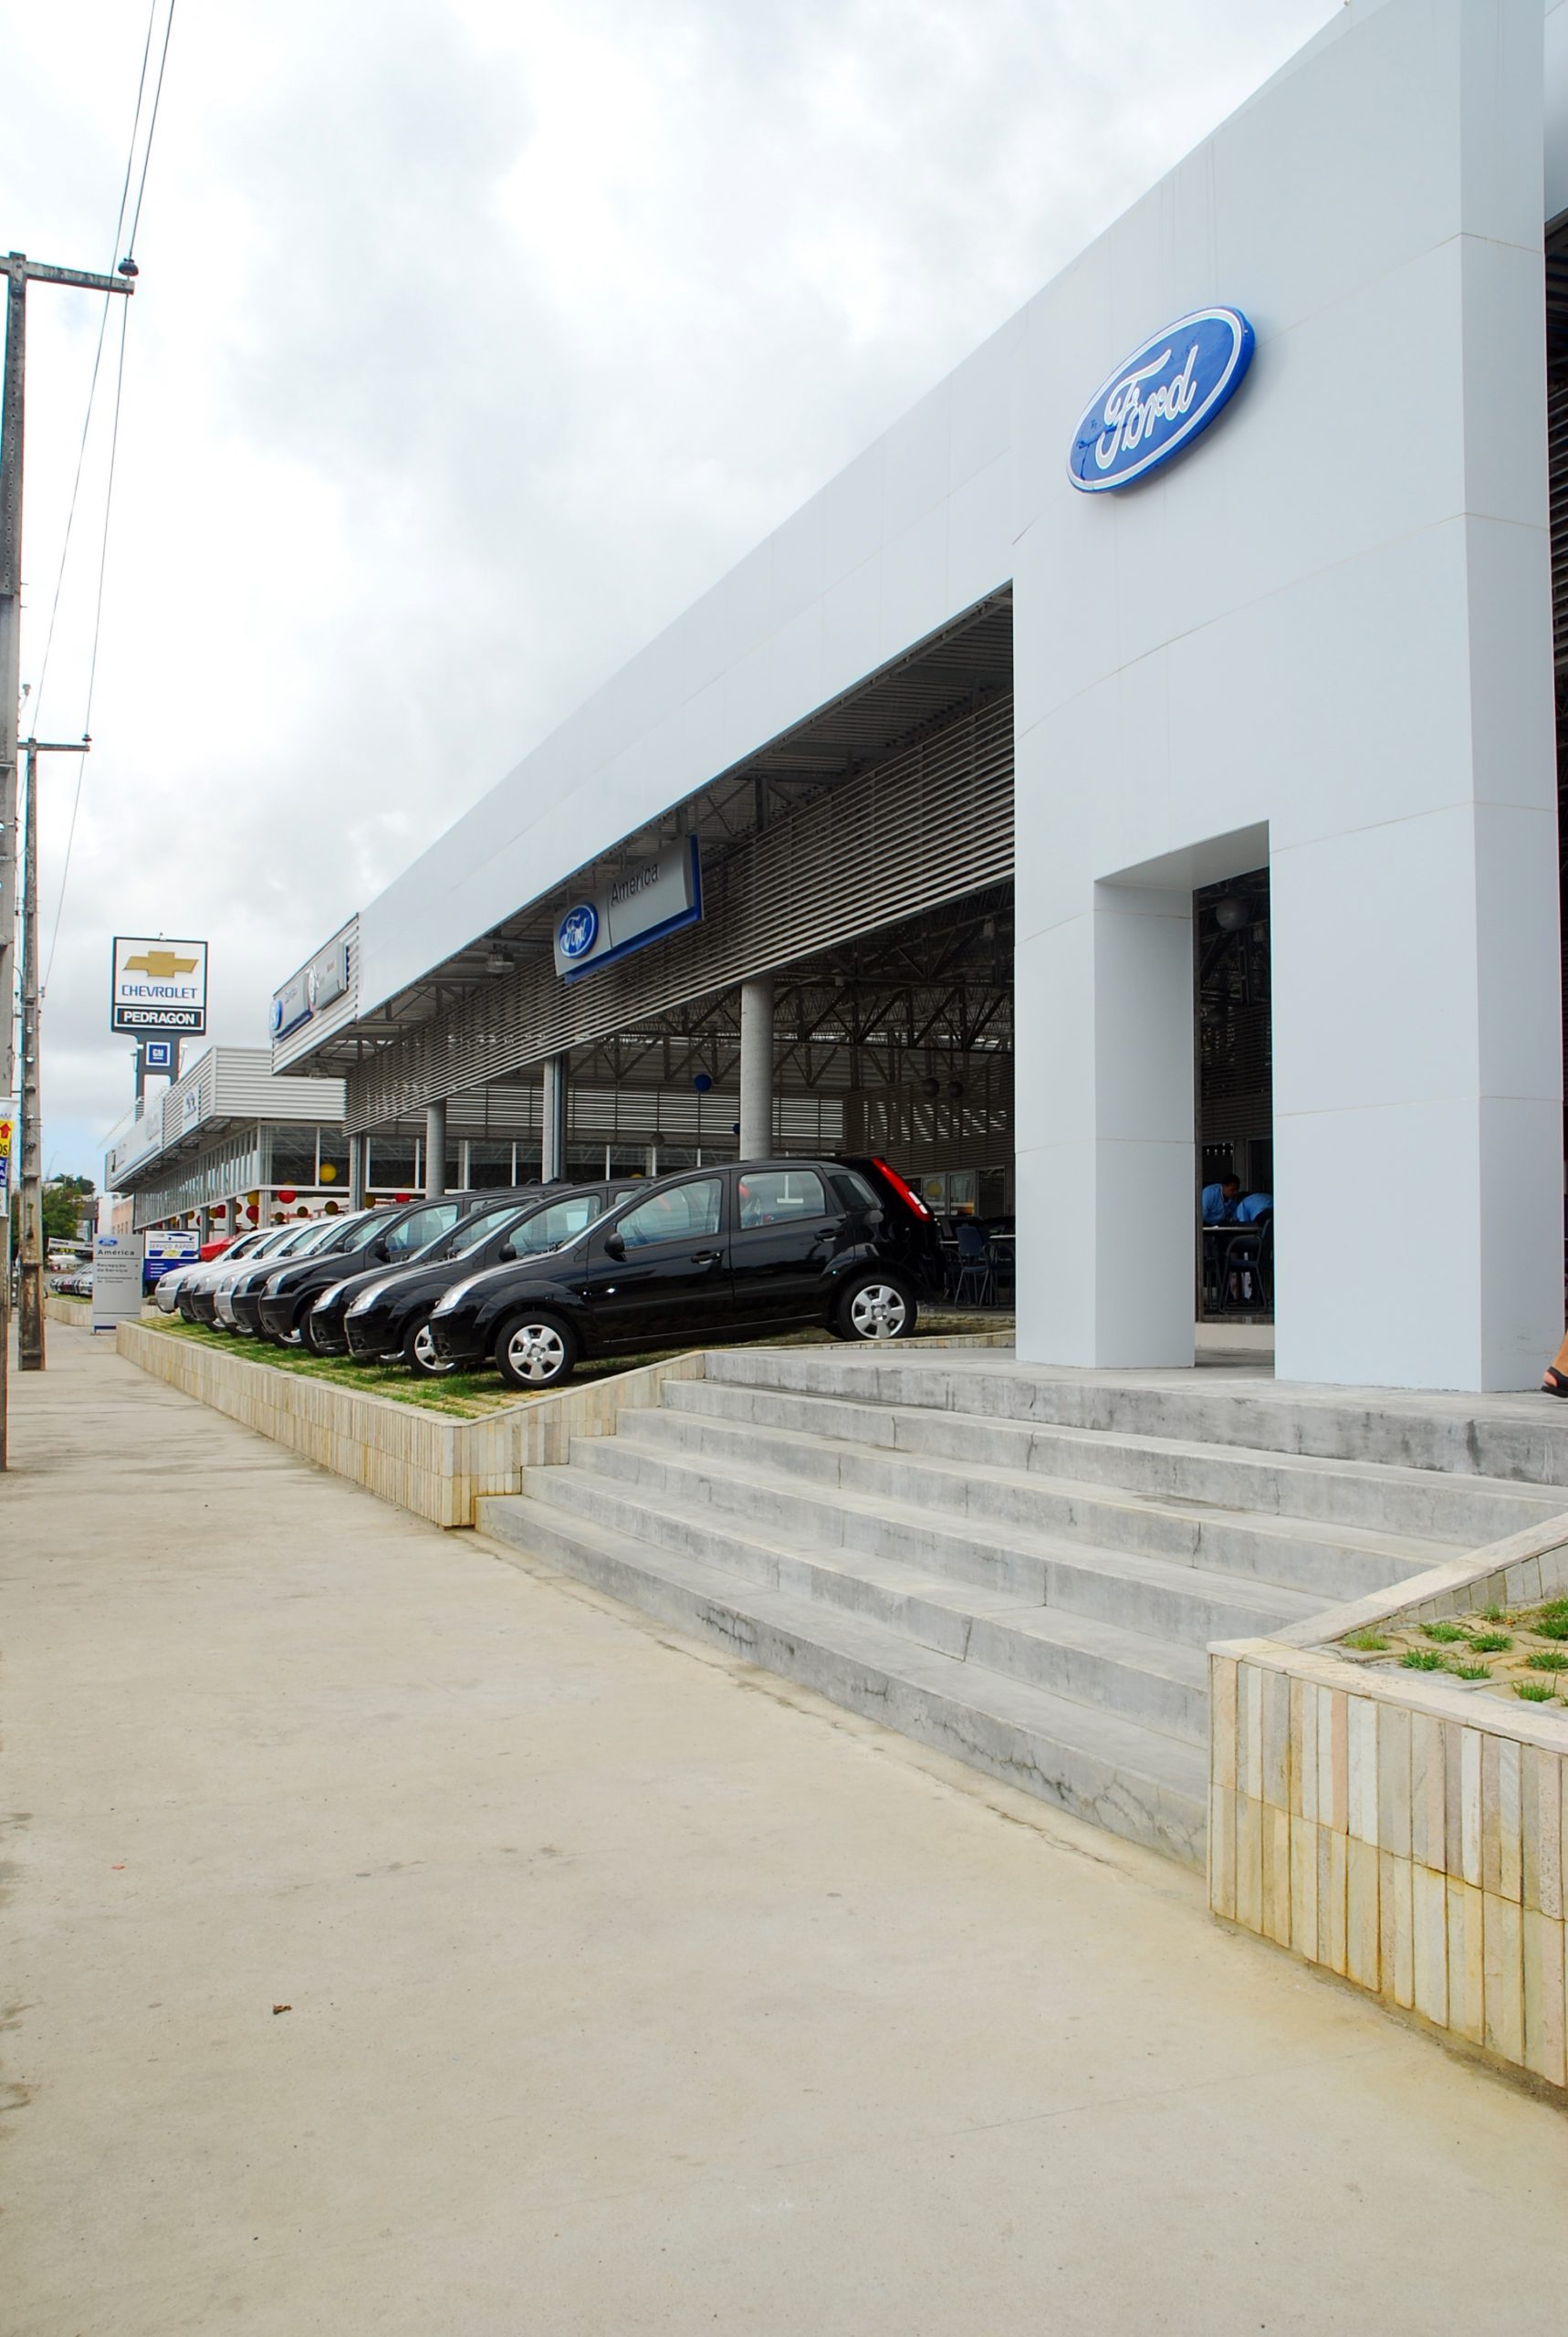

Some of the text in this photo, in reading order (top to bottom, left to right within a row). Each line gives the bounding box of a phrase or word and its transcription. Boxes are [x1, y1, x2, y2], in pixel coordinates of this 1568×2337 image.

[1095, 345, 1198, 469] Ford
[121, 984, 198, 1000] CHEVROLET
[123, 1011, 195, 1024] PEDRAGON
[152, 1048, 164, 1057] GM
